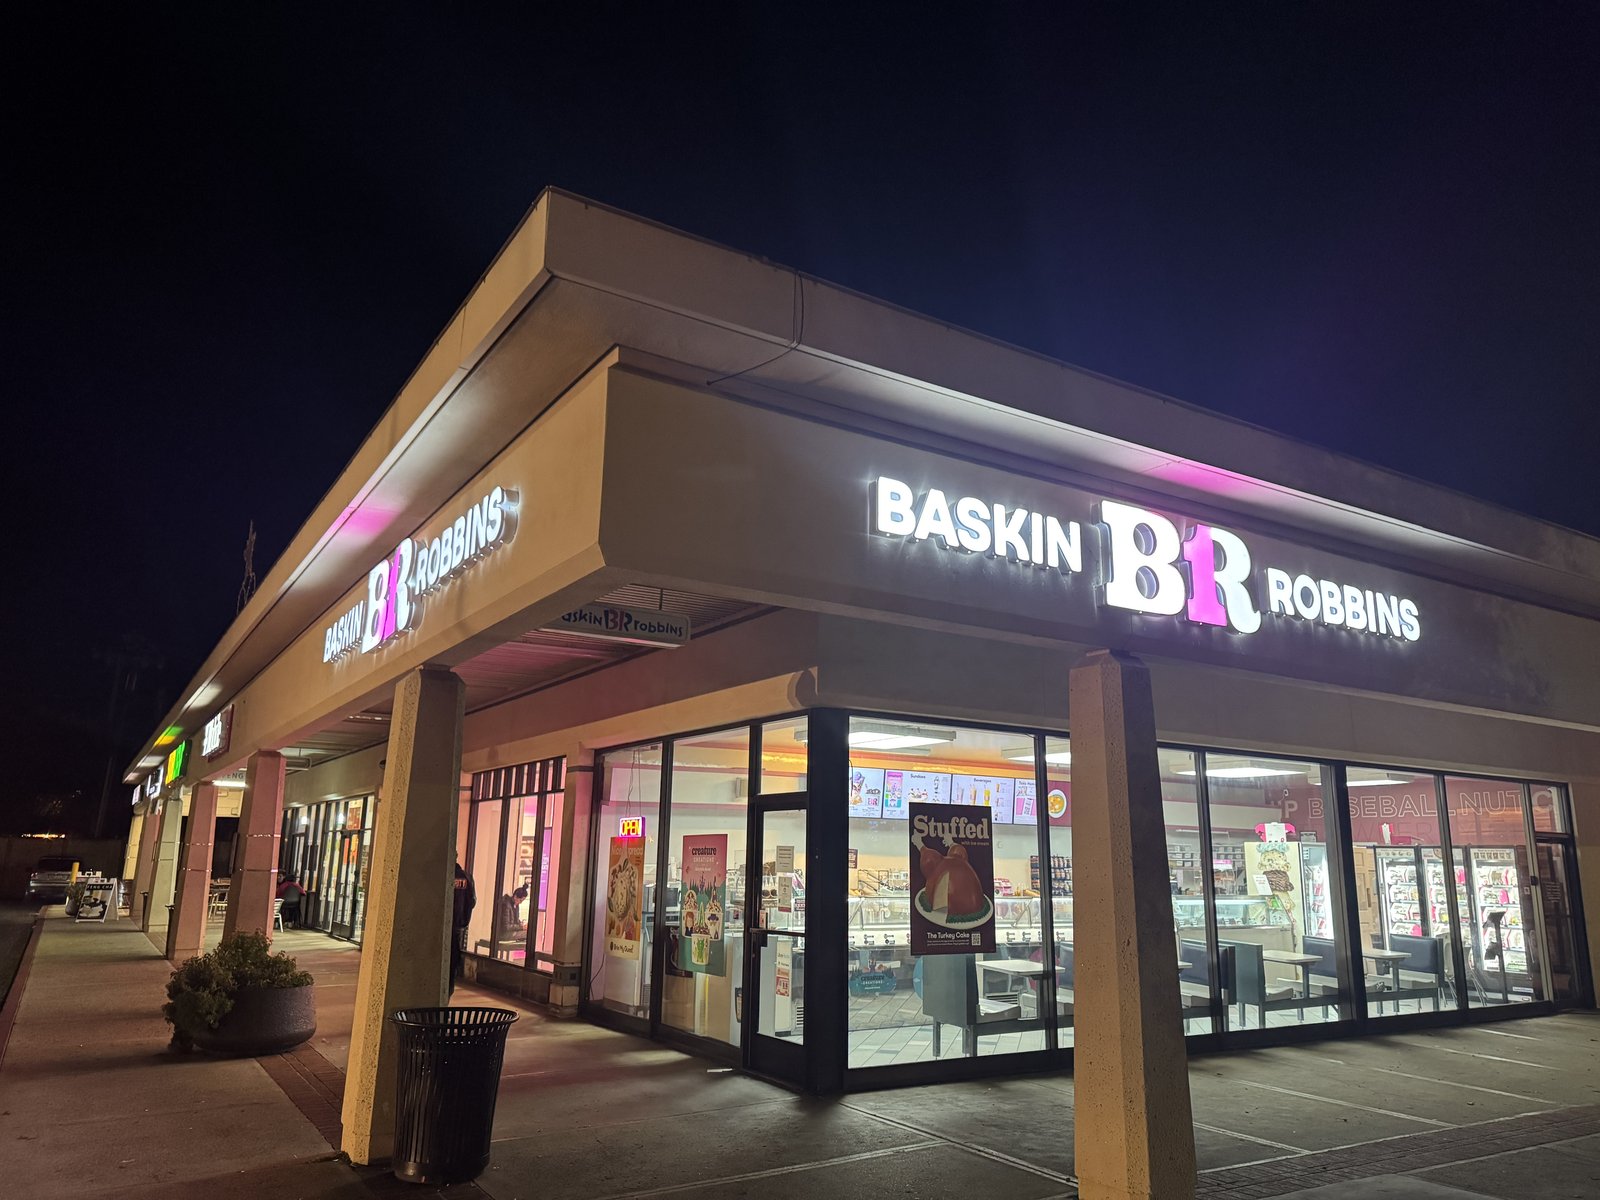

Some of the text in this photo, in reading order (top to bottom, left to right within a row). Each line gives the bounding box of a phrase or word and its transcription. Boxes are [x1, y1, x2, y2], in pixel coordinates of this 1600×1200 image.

[876, 476, 1421, 643] BASKIN BR ROBBINS
[323, 486, 506, 663] BASKIN BR ROBBINS
[561, 609, 603, 626] askin
[1307, 793, 1457, 819] BSEBAL
[621, 819, 641, 836] OPEN
[913, 814, 990, 840] Stuffed
[692, 845, 717, 856] creature
[938, 932, 955, 940] Turkey
